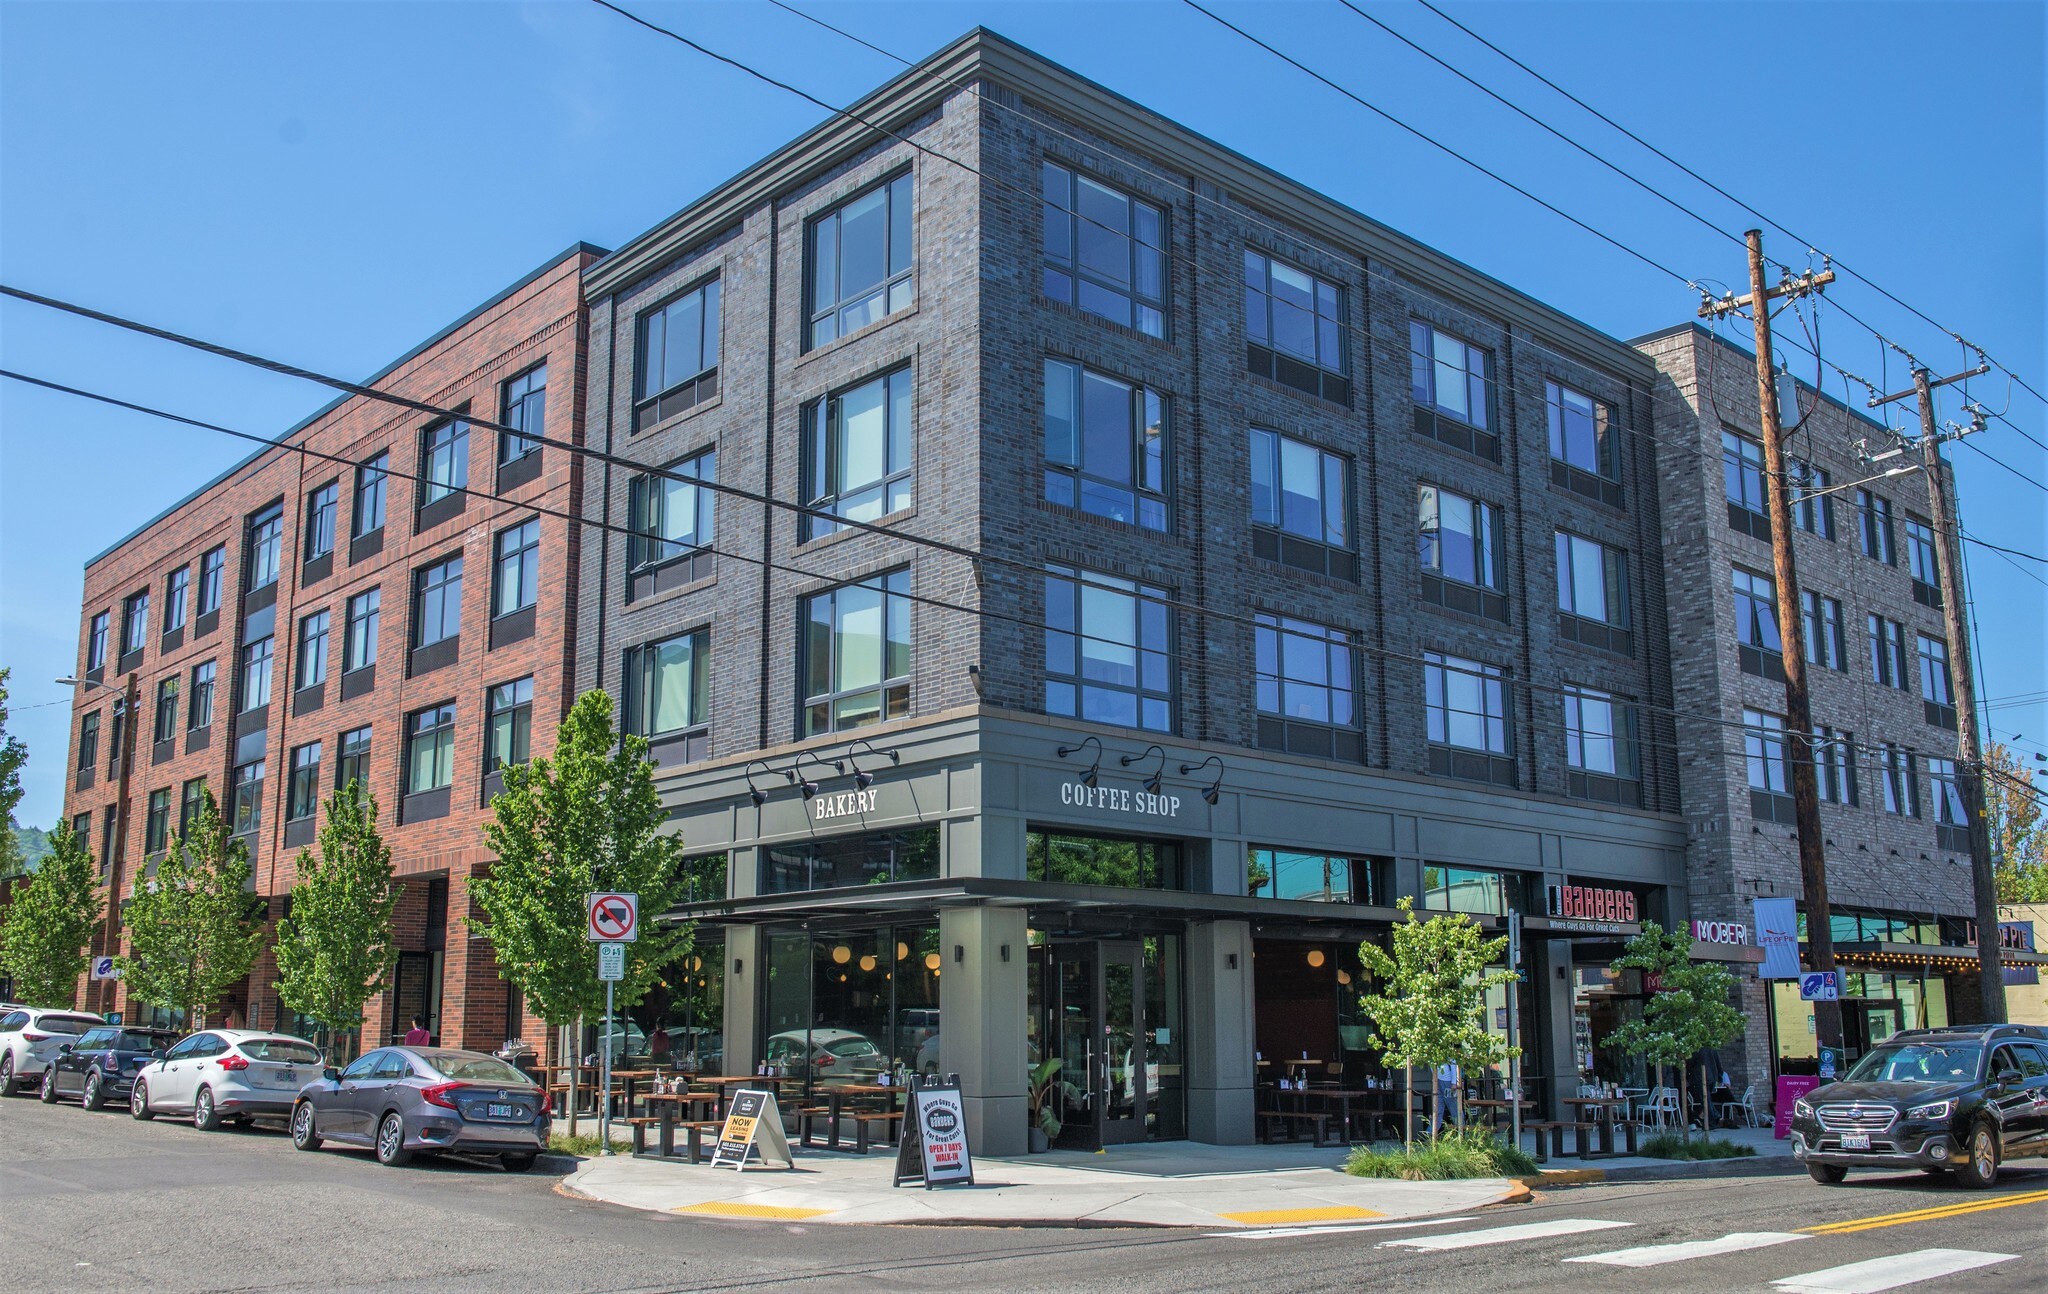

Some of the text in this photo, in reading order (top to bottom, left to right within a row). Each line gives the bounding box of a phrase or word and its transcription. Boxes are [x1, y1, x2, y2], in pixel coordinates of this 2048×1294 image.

[815, 789, 878, 820] BAKERY
[1060, 782, 1181, 818] COFFEE SHOP
[1549, 920, 1620, 933] Where Guys Go For Great Cuts
[1696, 920, 1748, 946] MOBERI
[2010, 926, 2029, 949] PIE
[923, 1098, 958, 1113] Where Guys Go
[732, 1117, 752, 1127] NOW
[926, 1130, 935, 1140] For
[949, 1128, 962, 1141] Cuts!
[929, 1144, 944, 1153] OPEN
[948, 1142, 963, 1152] DAYS
[935, 1152, 959, 1162] WALK-IN
